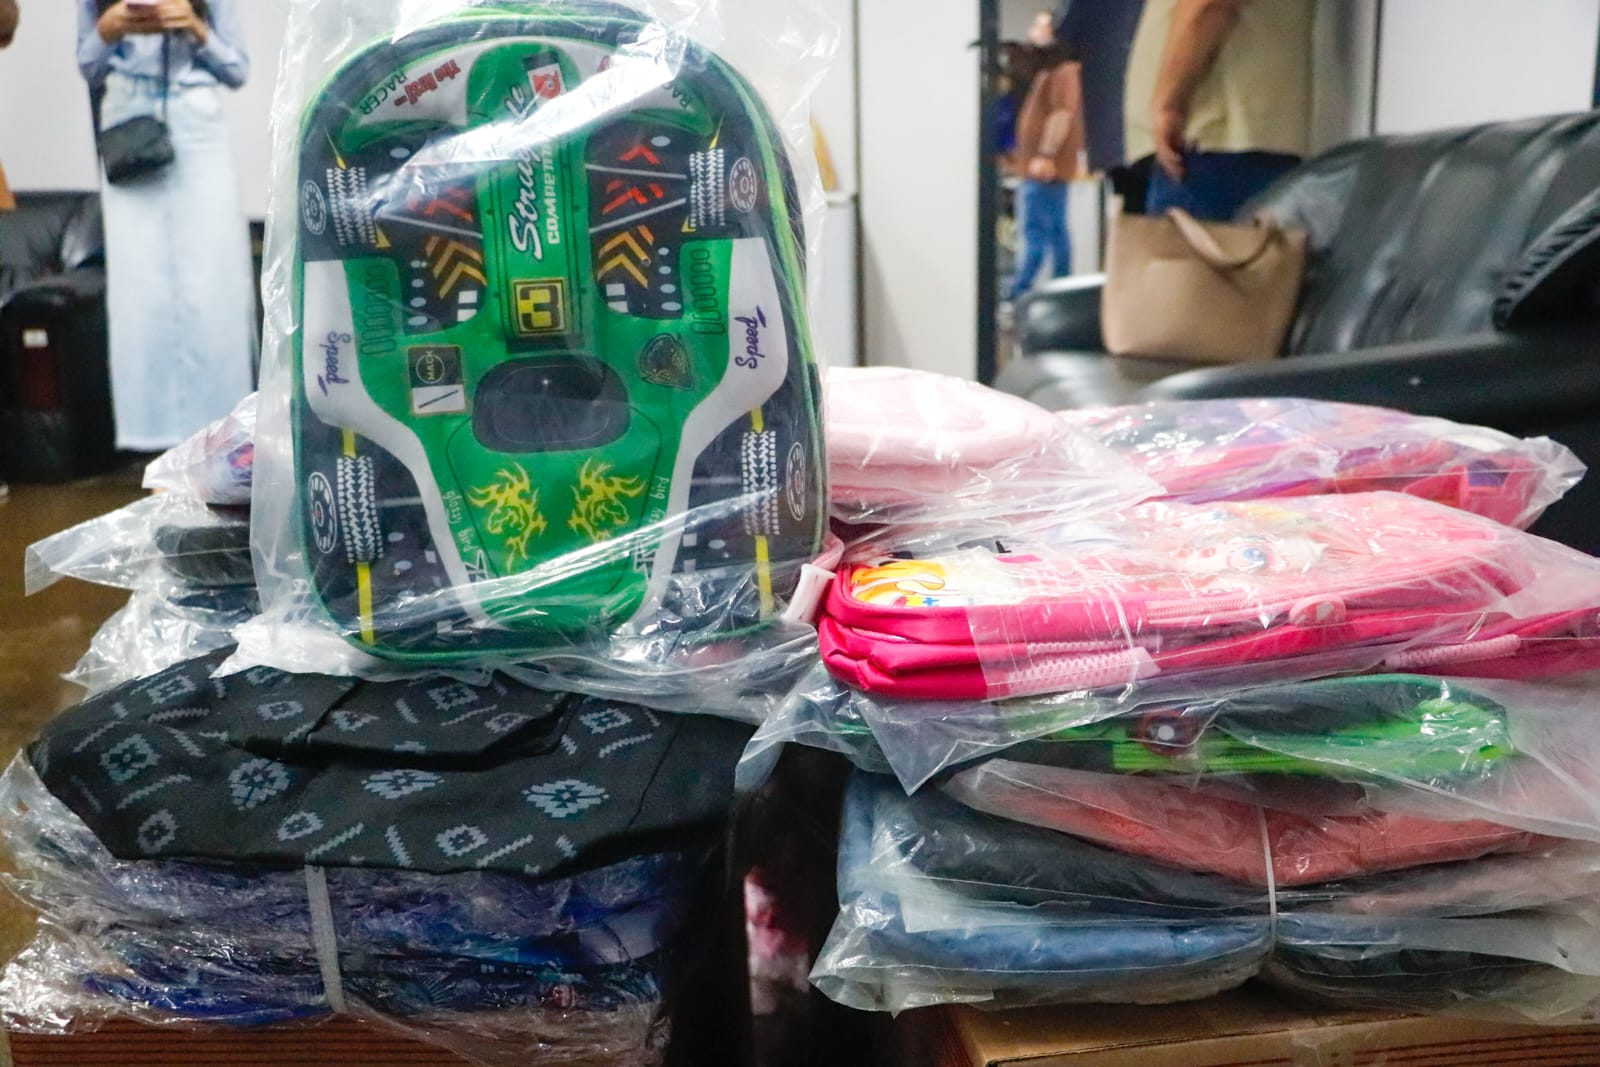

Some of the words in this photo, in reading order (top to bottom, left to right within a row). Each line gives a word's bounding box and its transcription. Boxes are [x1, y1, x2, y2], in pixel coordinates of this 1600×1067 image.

[359, 69, 407, 115] RACER
[319, 331, 352, 385] Speed
[734, 316, 766, 370] Speed
[649, 475, 670, 500] bird
